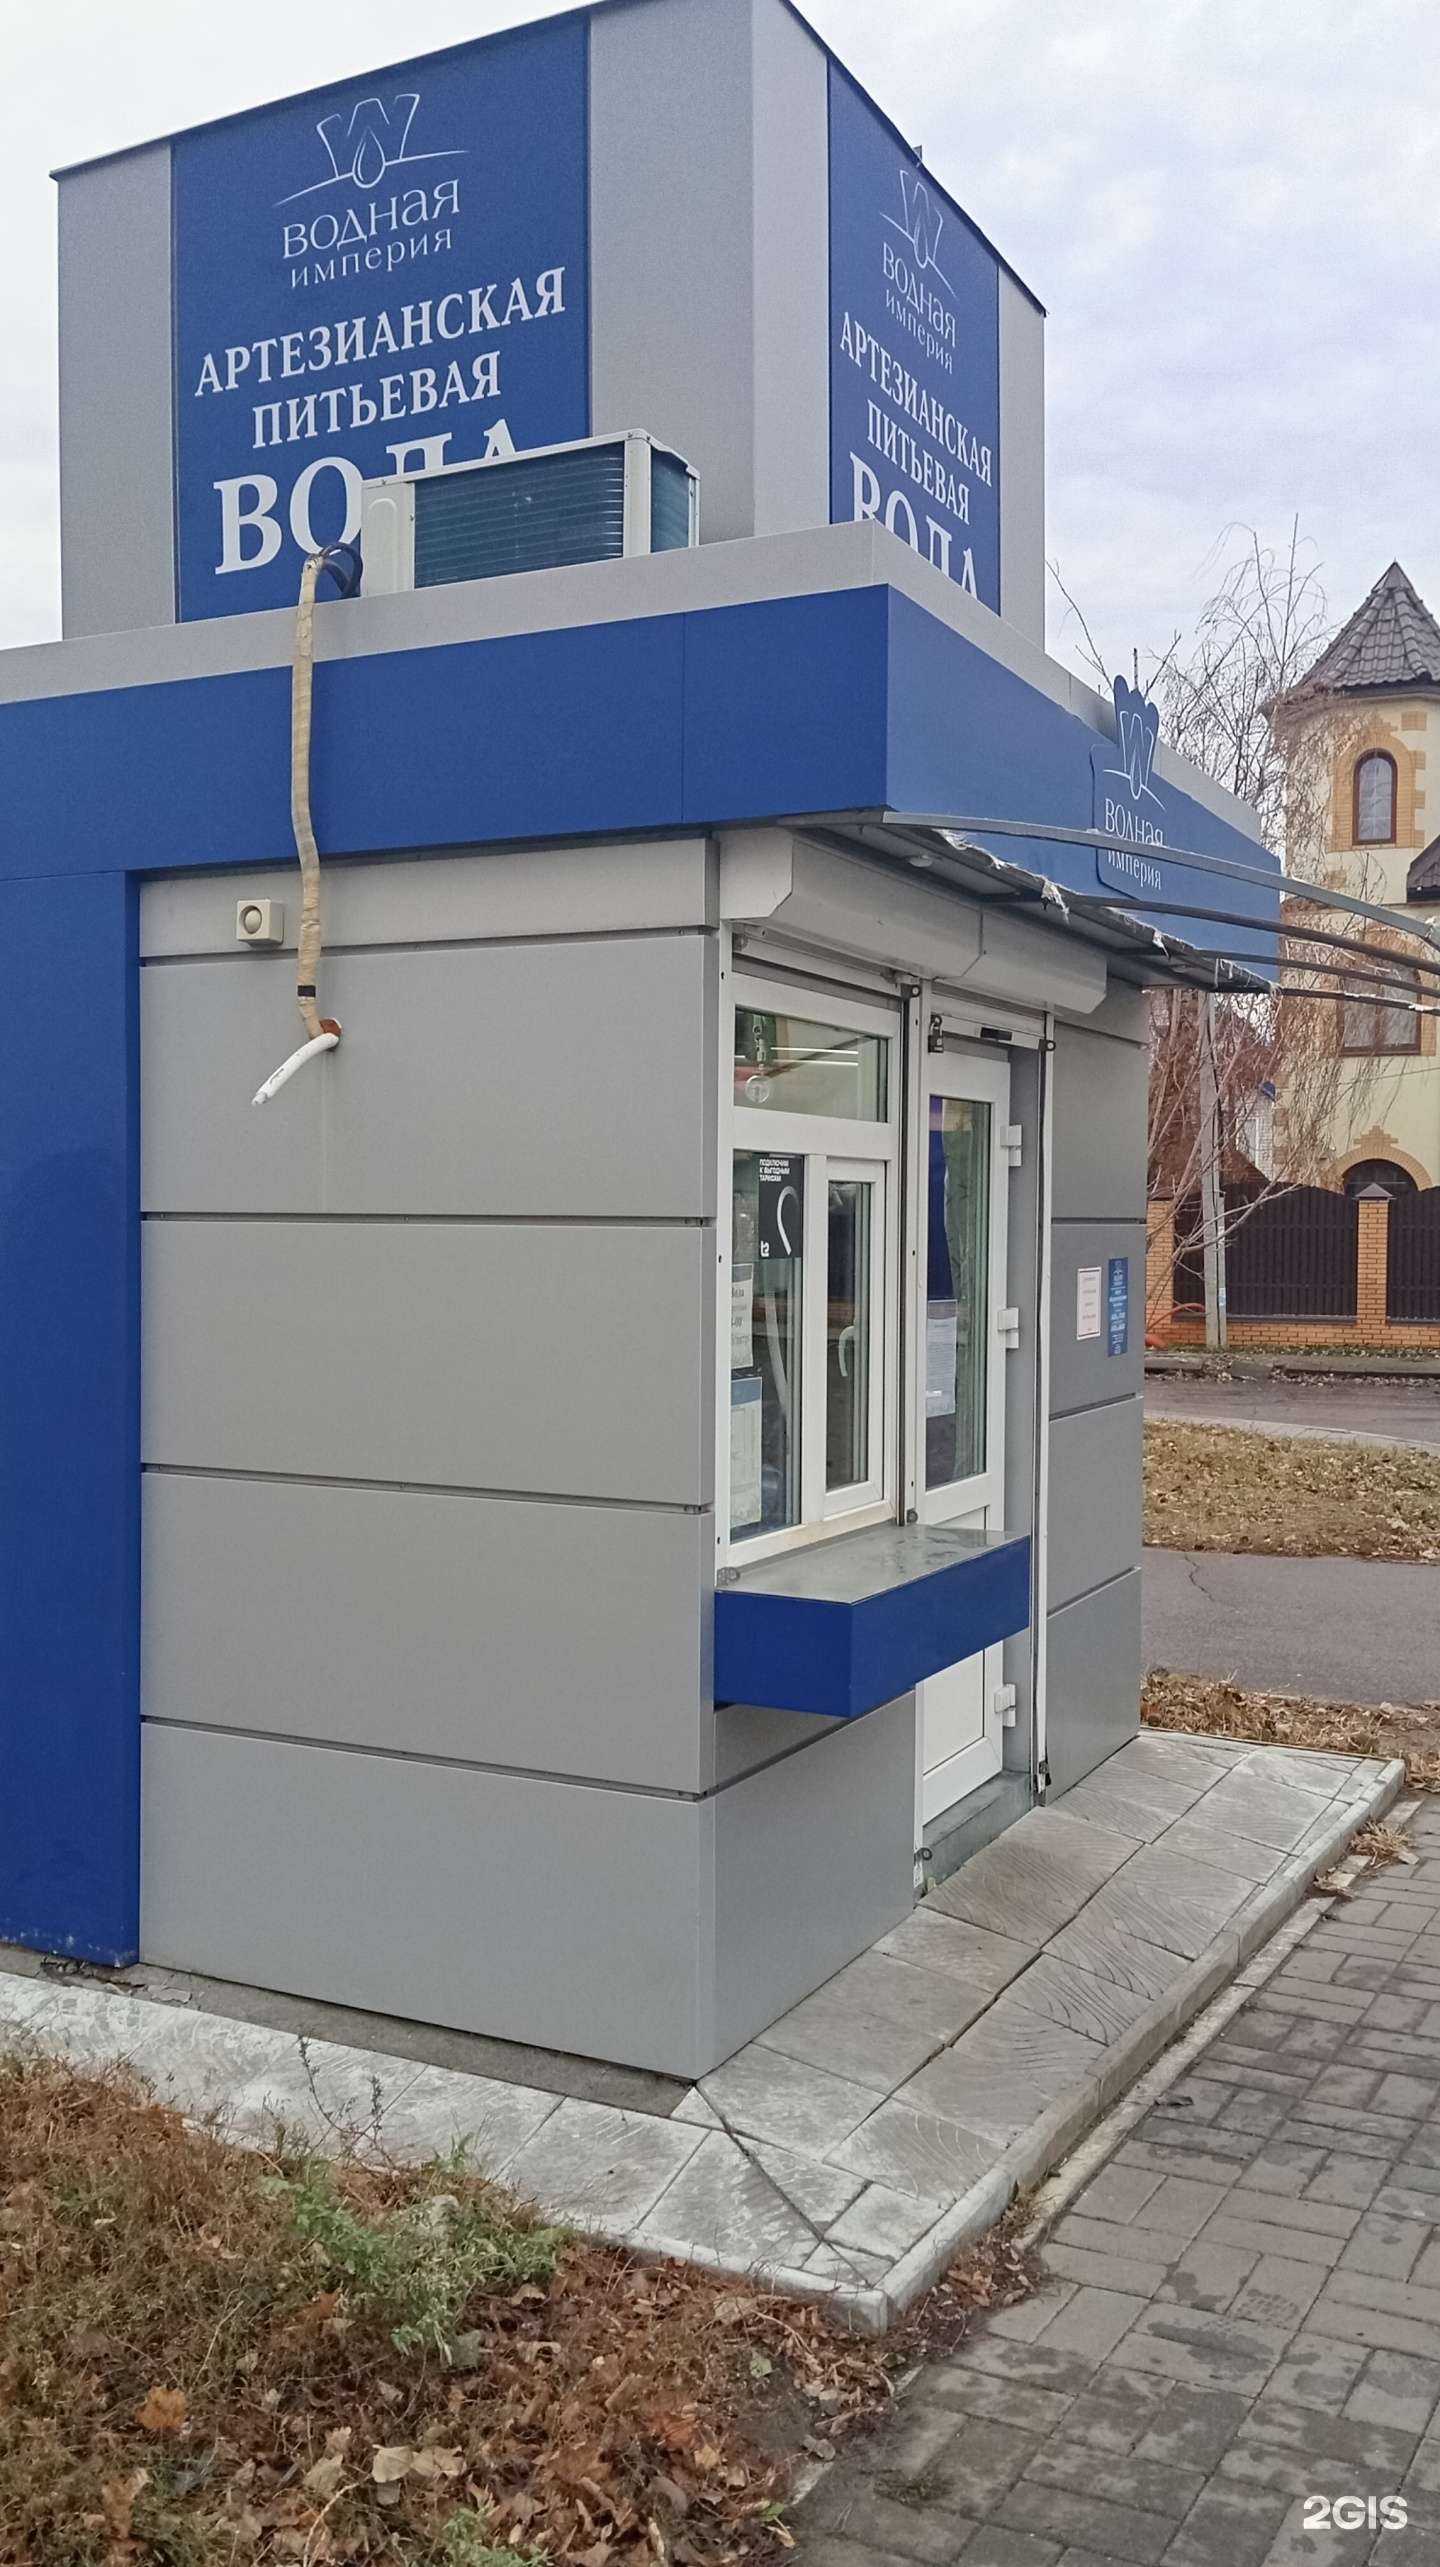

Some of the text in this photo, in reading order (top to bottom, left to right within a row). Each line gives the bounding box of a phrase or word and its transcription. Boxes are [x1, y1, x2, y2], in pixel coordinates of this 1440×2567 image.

[290, 228, 453, 288] империя
[194, 266, 567, 396] АРТЕЗИАНСКАЯ
[886, 288, 953, 375] империя
[252, 351, 502, 449] ПИТЬЕВАЯ
[840, 311, 993, 487] АРТЕЗИАНСКАЯ
[867, 399, 971, 526] ПИТЬЕВАЯ
[213, 418, 518, 575] ВО
